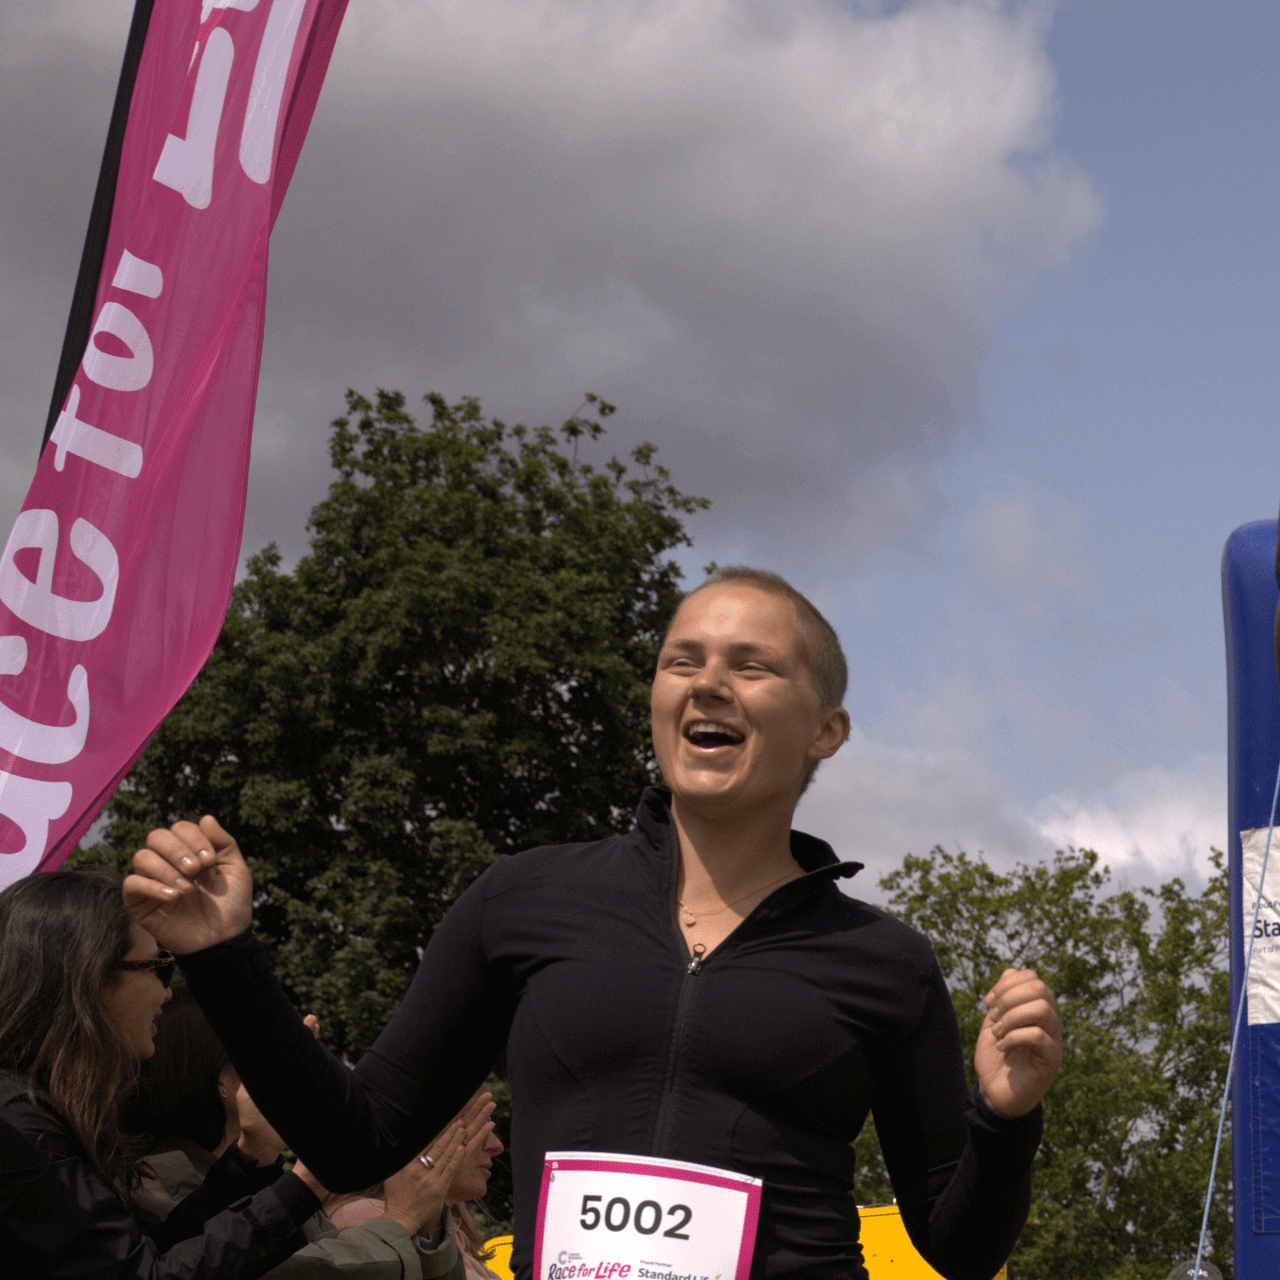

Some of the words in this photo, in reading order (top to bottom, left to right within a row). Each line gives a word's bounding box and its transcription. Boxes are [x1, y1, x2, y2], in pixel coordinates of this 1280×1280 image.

[579, 1194, 693, 1241] 5002
[576, 1263, 596, 1278] for
[594, 1261, 631, 1280] Life
